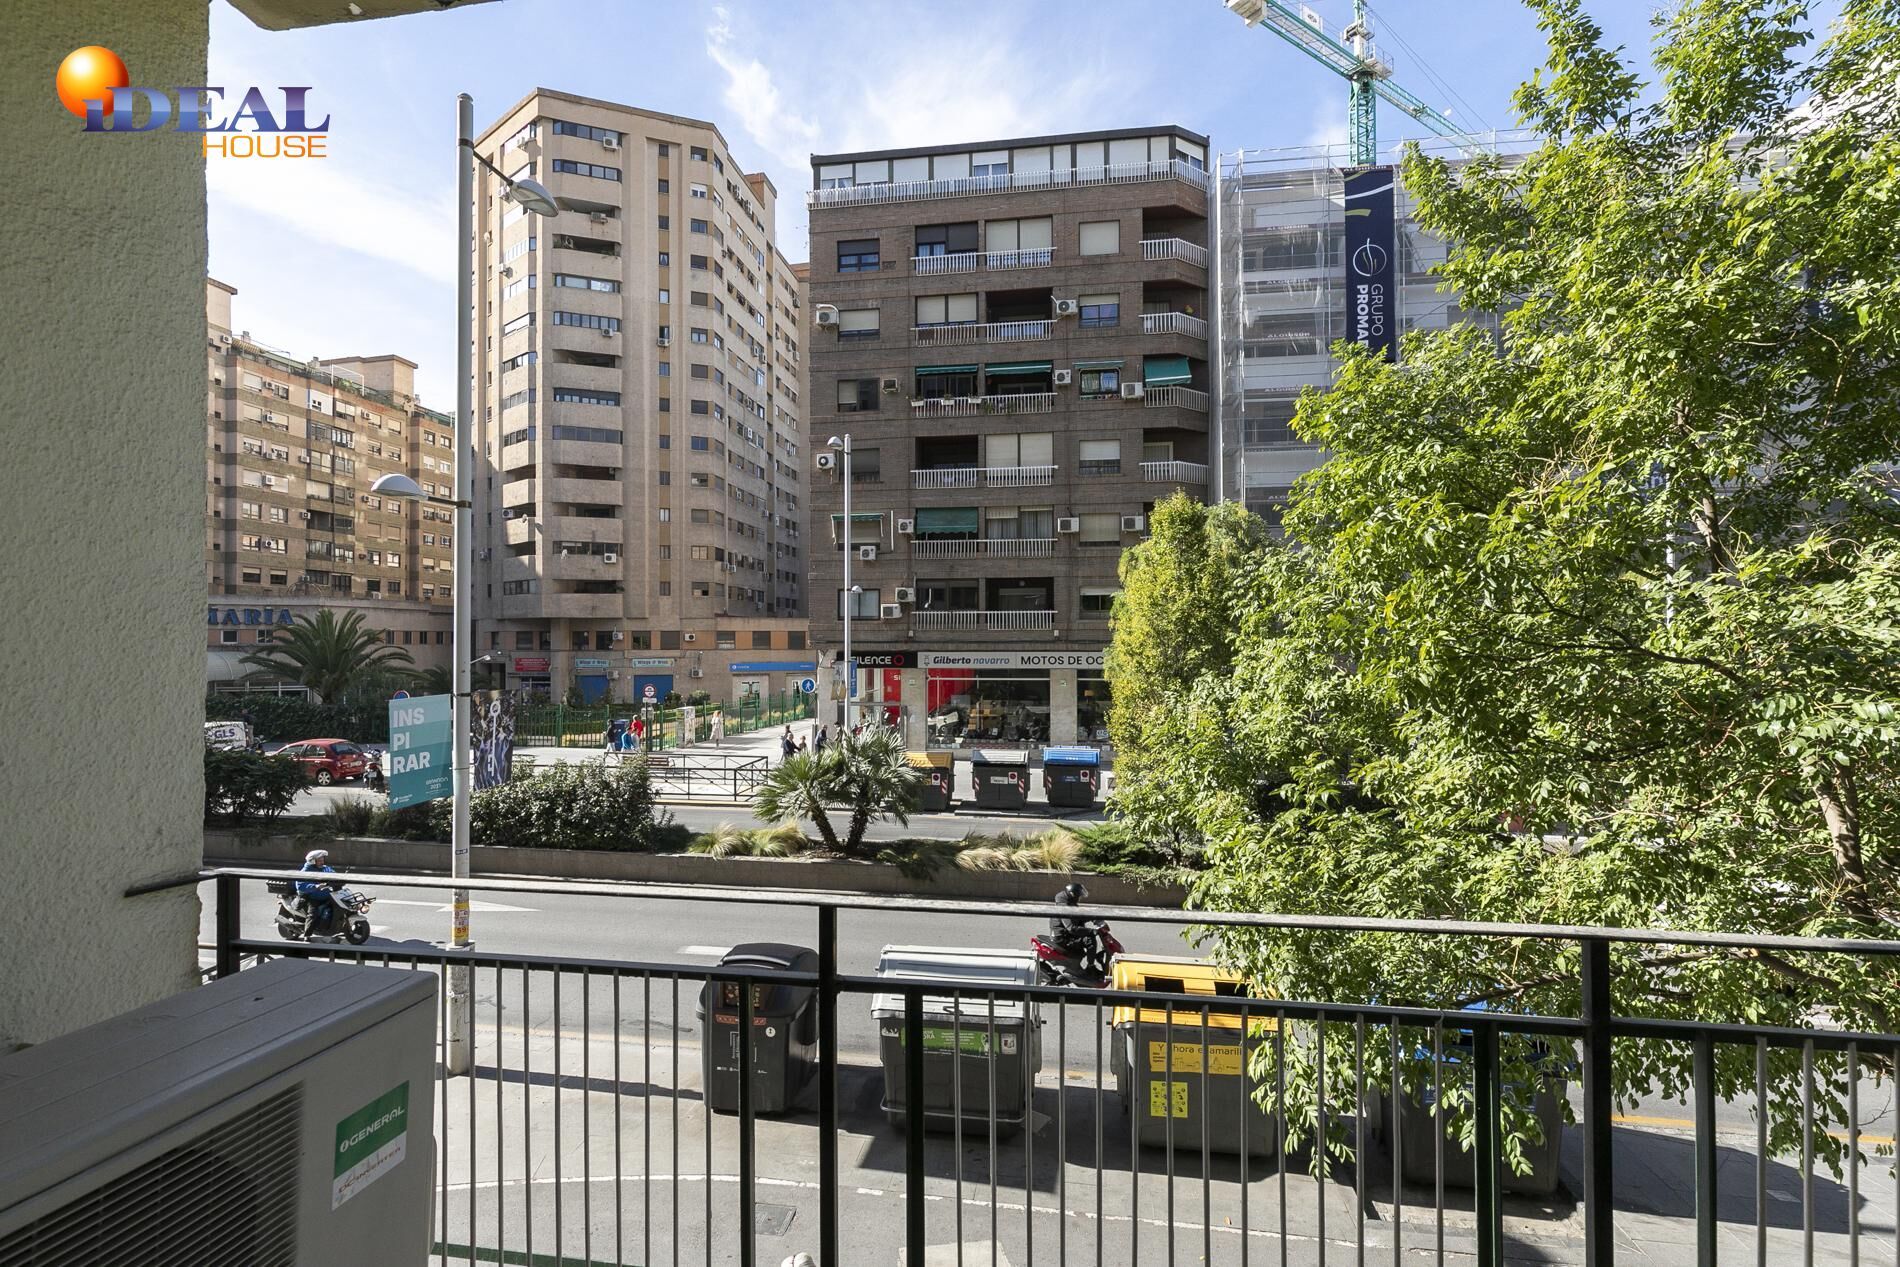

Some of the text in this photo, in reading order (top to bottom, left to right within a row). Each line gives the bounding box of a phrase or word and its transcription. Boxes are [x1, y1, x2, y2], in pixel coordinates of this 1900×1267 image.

[1371, 283, 1384, 336] GRUPO
[933, 656, 971, 665] Gilberto
[973, 657, 1010, 665] navarro
[1020, 655, 1065, 666] MOTOS
[1067, 655, 1083, 666] DE
[393, 707, 425, 728] INS
[214, 728, 236, 739] GLS
[393, 731, 410, 752] PI
[393, 751, 431, 775] RAR
[1158, 1043, 1165, 1051] Y
[1173, 1044, 1195, 1054] hora
[1209, 1047, 1243, 1056] amarill
[350, 1106, 405, 1146] GENERAL
